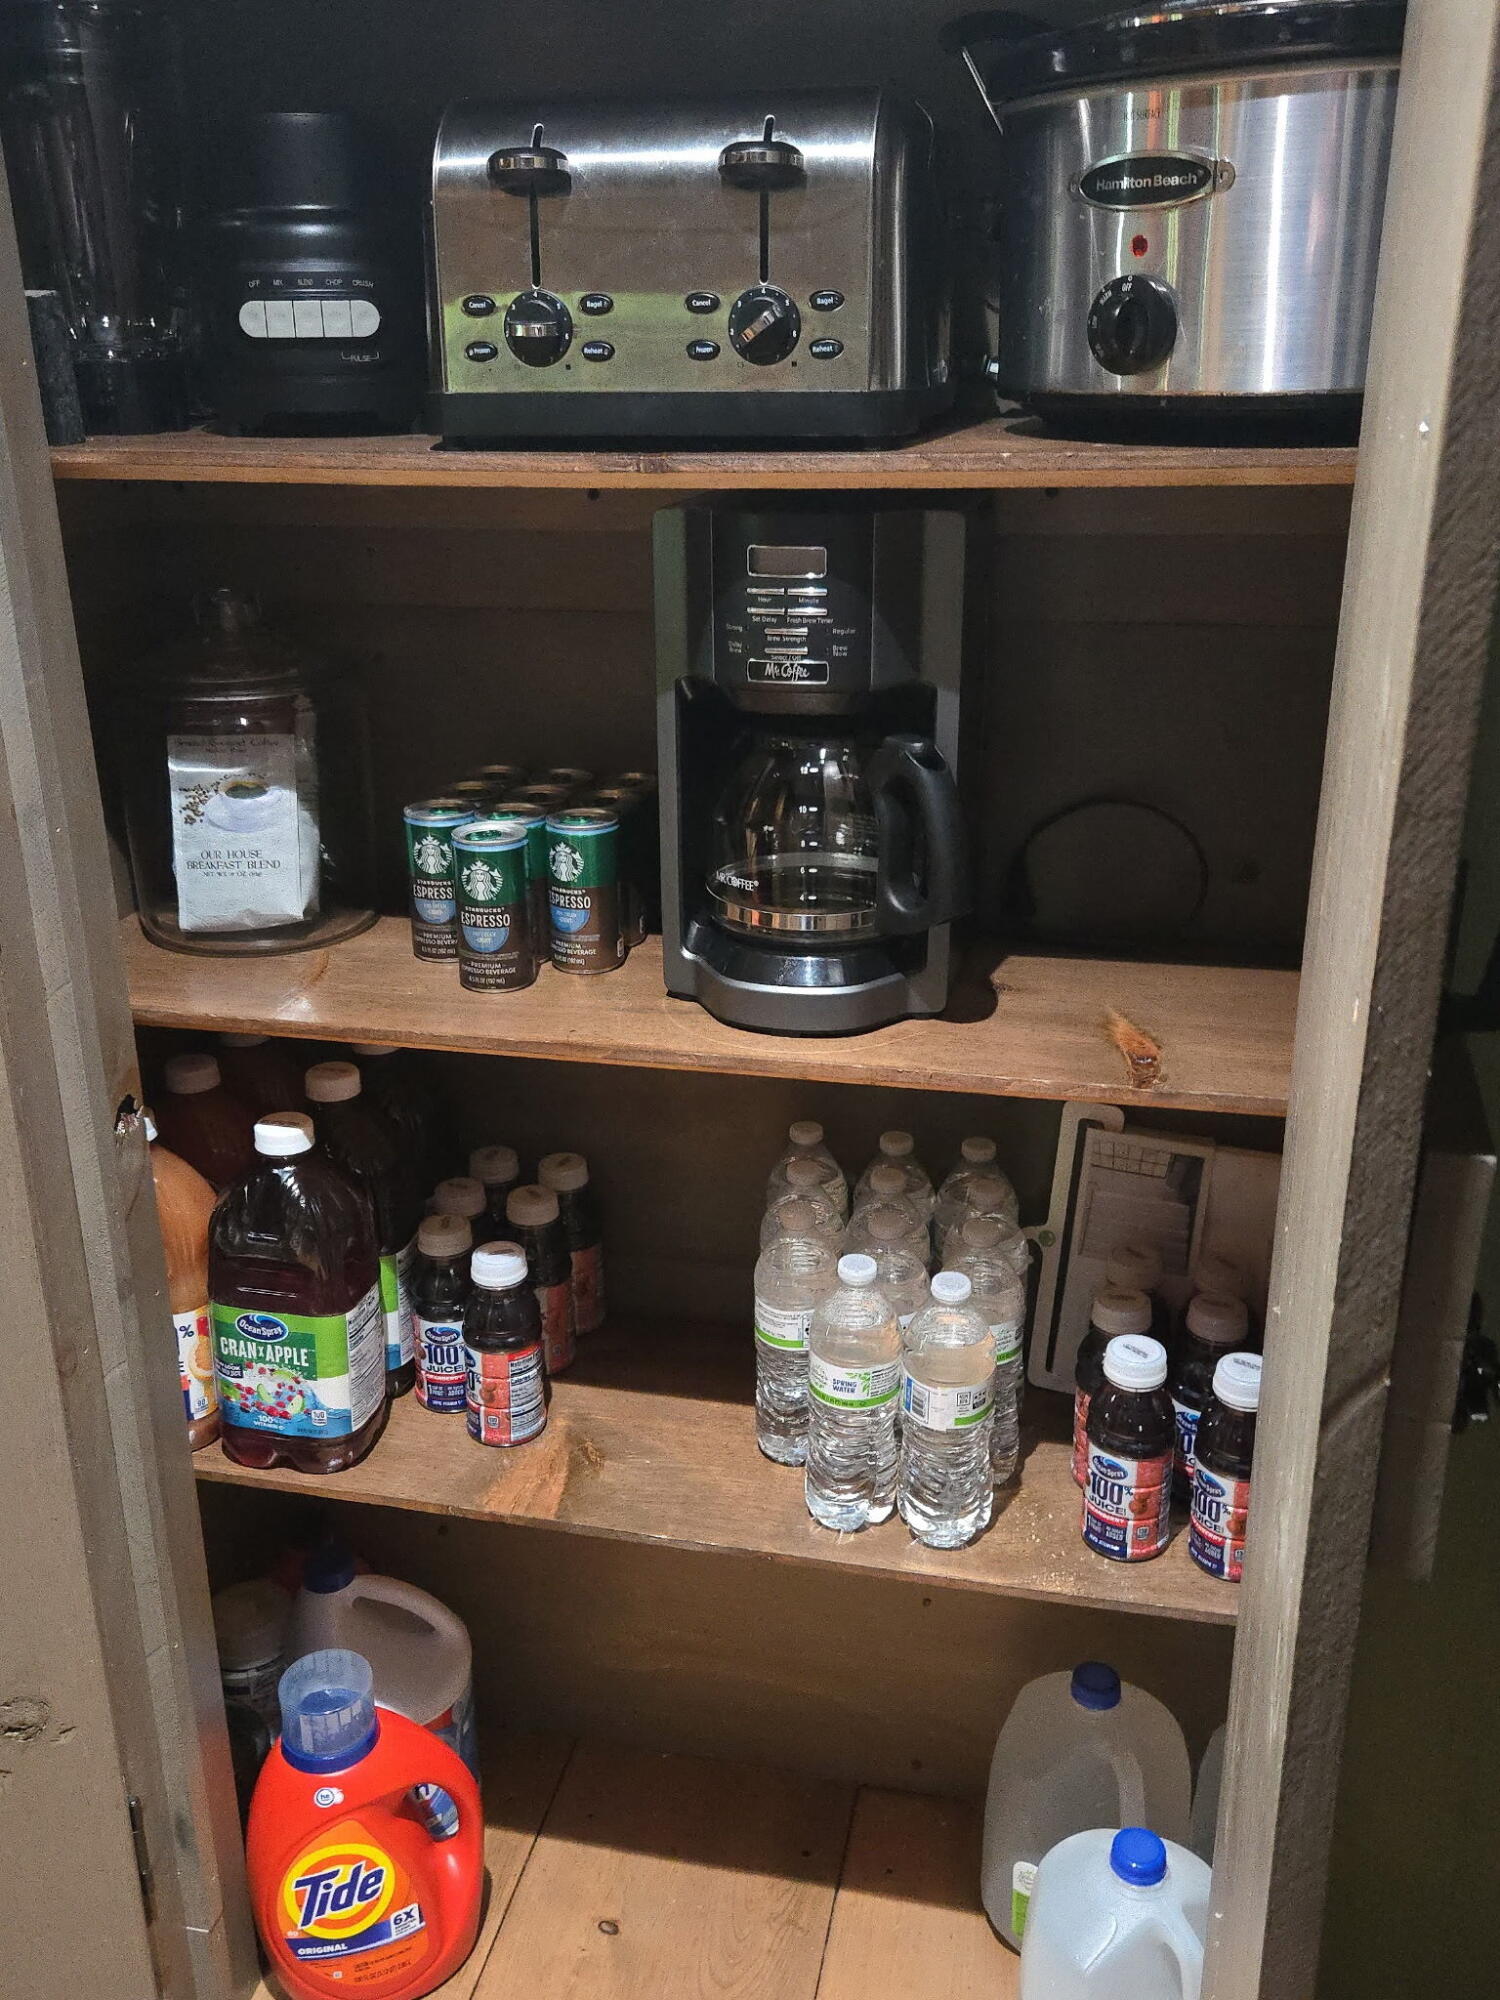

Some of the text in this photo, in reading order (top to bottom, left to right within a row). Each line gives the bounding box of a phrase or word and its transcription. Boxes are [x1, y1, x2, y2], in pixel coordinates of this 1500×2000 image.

[1153, 172, 1198, 187] Beach
[325, 279, 343, 287] CHOP
[1121, 282, 1132, 292] OFF
[468, 301, 487, 309] Cancel
[586, 300, 603, 310] Bagel
[691, 299, 712, 307] Cancel
[816, 297, 834, 306] Bagel
[583, 347, 604, 355] Reheat
[812, 345, 833, 353] Reheat
[762, 615, 778, 624] Delay
[832, 627, 856, 636] Regular
[782, 635, 808, 644] Strength
[780, 661, 810, 683] Coffee
[799, 805, 808, 813] 10
[200, 849, 263, 860] OUR HOUSE
[186, 859, 281, 870] BREAKFAST BLEND
[413, 883, 455, 900] ESPRESS
[465, 905, 501, 913] STARBUCKS
[460, 911, 511, 928] ESPRESSO
[567, 945, 597, 956] BEVERAGE
[470, 961, 502, 969] PREMIUM
[485, 966, 516, 975] BEVERAGE
[239, 1319, 283, 1337] Ocean Spray
[832, 1378, 857, 1387] SPRING
[832, 1385, 856, 1394] WATER
[1090, 1472, 1134, 1506] 100%
[292, 1861, 386, 1929] Tide
[393, 1907, 415, 1926] 6X
[297, 1942, 349, 1956] ORIGINAL
